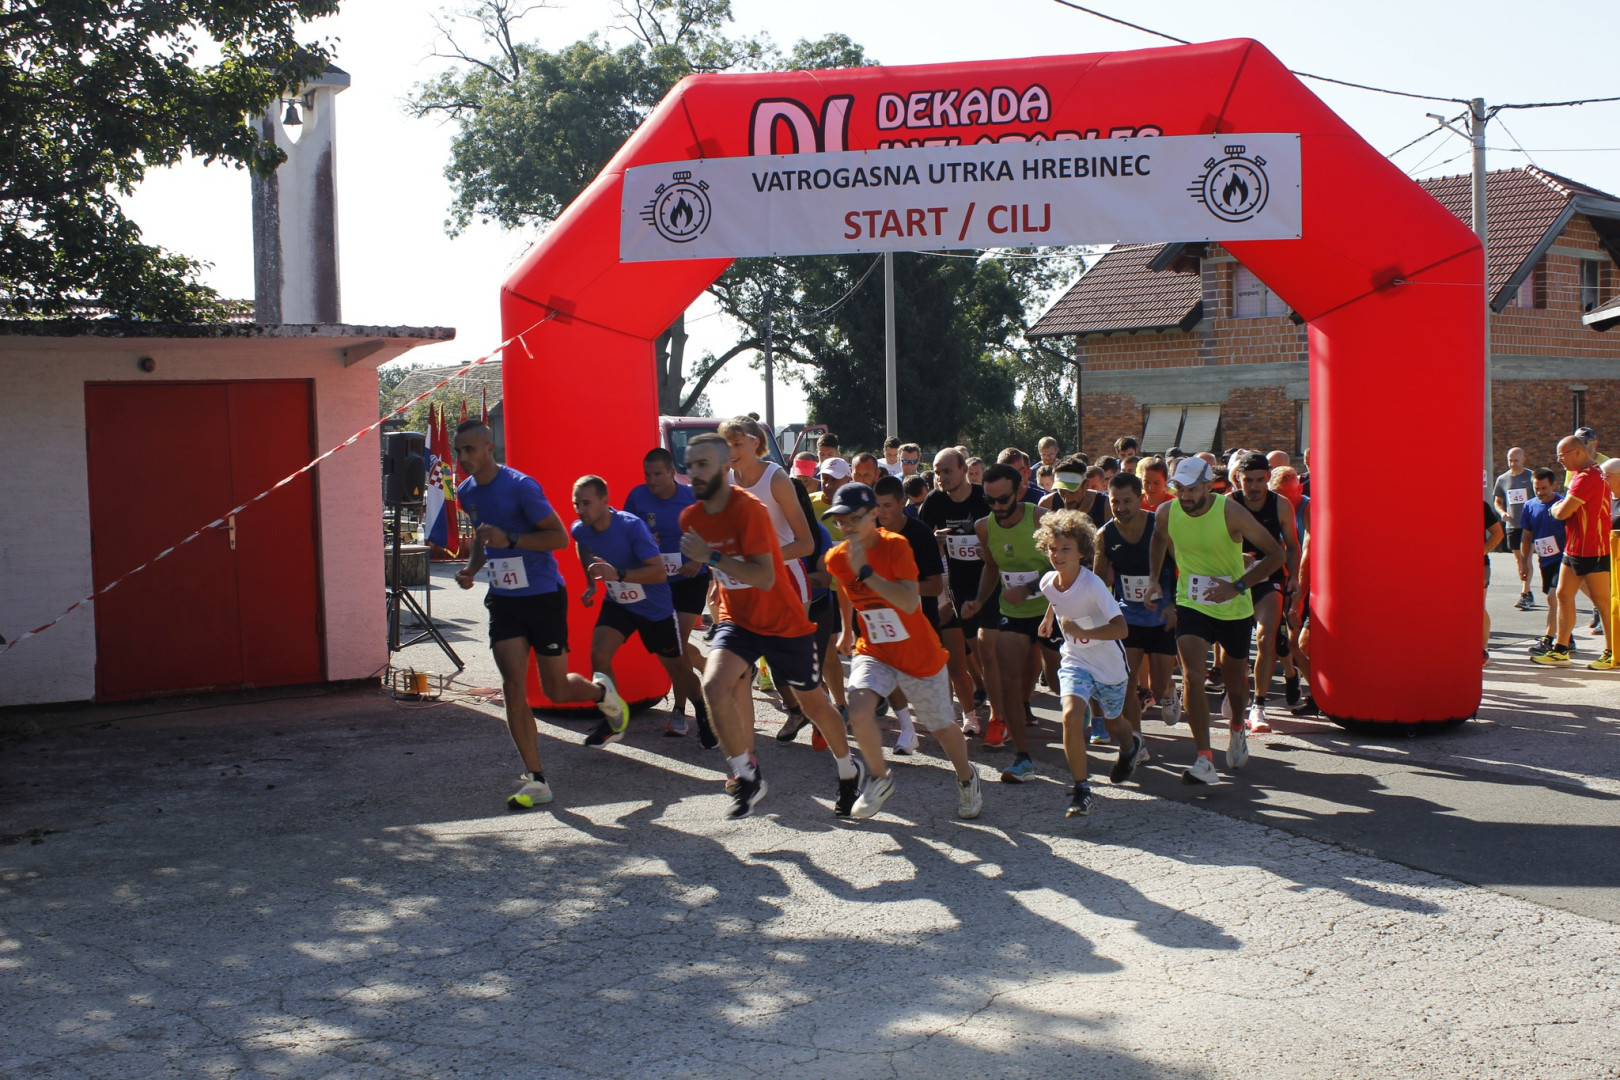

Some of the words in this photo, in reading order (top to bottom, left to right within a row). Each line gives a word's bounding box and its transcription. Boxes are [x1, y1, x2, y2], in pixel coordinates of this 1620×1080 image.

[877, 84, 1051, 131] DEKADA
[751, 164, 921, 193] VATROGASNA
[928, 160, 1014, 185] UTRKA
[1022, 154, 1151, 181] HREBINEC
[843, 207, 949, 240] START
[958, 202, 976, 242] /
[987, 203, 1051, 234] CILJ
[958, 546, 977, 558] 65
[1542, 545, 1554, 555] 26
[502, 571, 519, 586] 41
[620, 590, 639, 601] 40
[880, 624, 897, 638] 13
